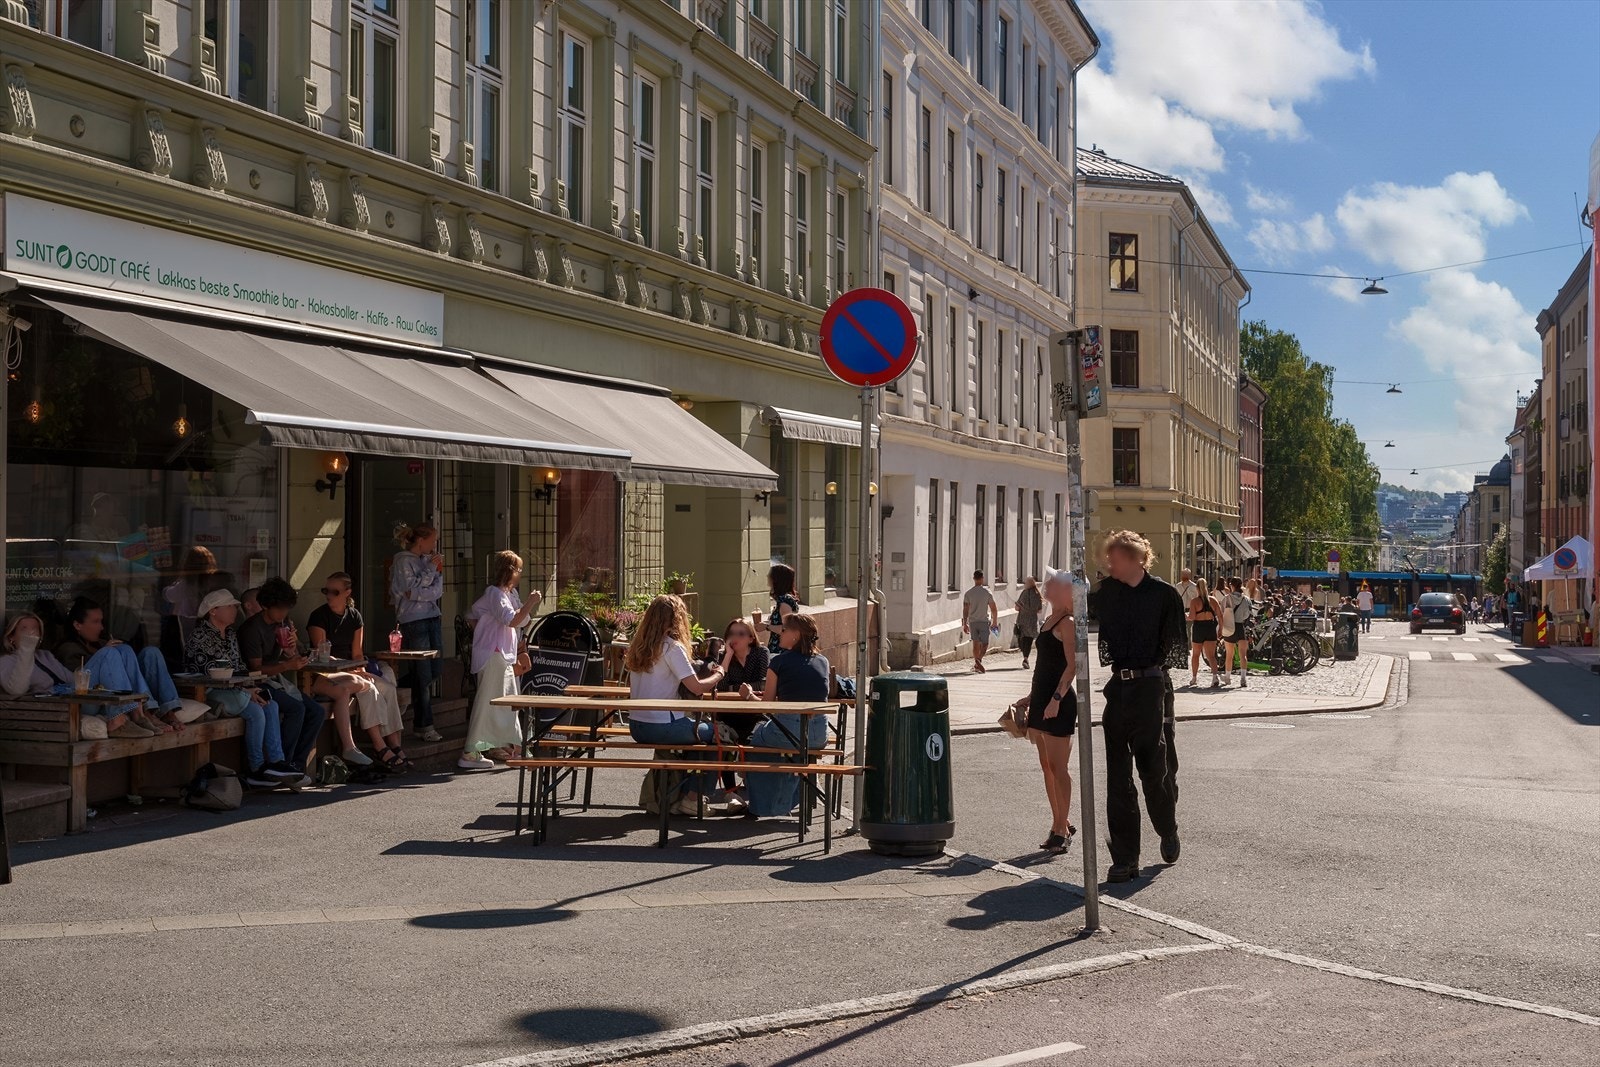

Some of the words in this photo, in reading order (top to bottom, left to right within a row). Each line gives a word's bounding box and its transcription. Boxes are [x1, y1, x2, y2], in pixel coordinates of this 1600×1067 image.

[16, 239, 54, 263] SUNT
[75, 251, 117, 275] GODT
[120, 261, 150, 281] CAFÉ
[157, 268, 196, 291] Løkkas
[199, 276, 230, 297] beste
[233, 283, 279, 306] Smoothie
[282, 292, 299, 310] bar
[308, 297, 359, 320] Kokosboller
[366, 309, 389, 326] Kaffe
[396, 315, 414, 332] Raw
[415, 319, 438, 336] Cakes
[6, 567, 21, 579] UNT
[31, 567, 54, 577] GODT
[6, 592, 37, 602] okosboller
[533, 656, 571, 668] Velkommen
[572, 661, 581, 670] til
